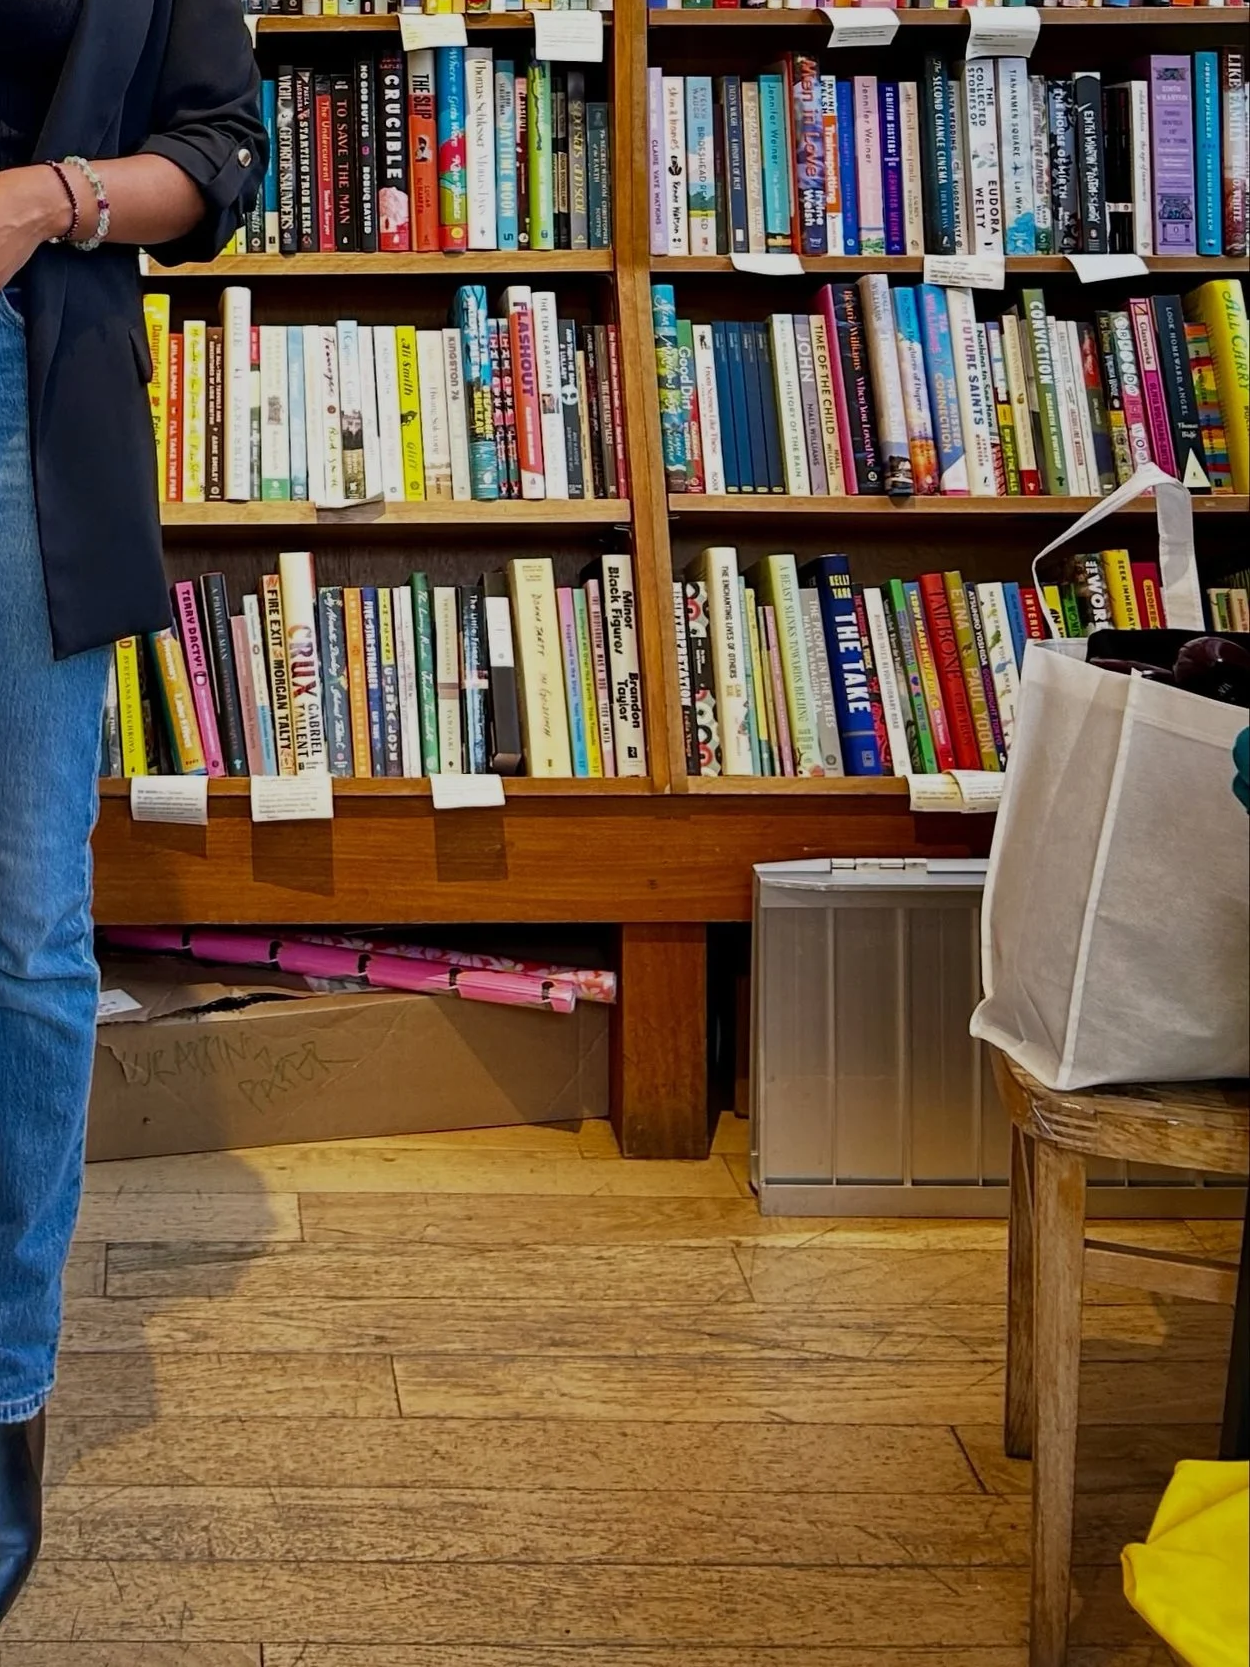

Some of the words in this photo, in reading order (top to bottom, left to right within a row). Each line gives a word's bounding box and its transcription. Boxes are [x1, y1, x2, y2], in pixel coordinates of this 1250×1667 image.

[384, 74, 403, 180] CRUCIBLE
[975, 187, 986, 229] WELTY
[988, 180, 1000, 235] EUDORA
[513, 301, 535, 398] FLASHOUT
[1029, 301, 1050, 385] CONVICTION
[607, 566, 620, 604] Black
[622, 589, 634, 630] Minor
[288, 624, 318, 698] CRUX
[834, 613, 858, 654] THE
[842, 659, 872, 714] TAKE
